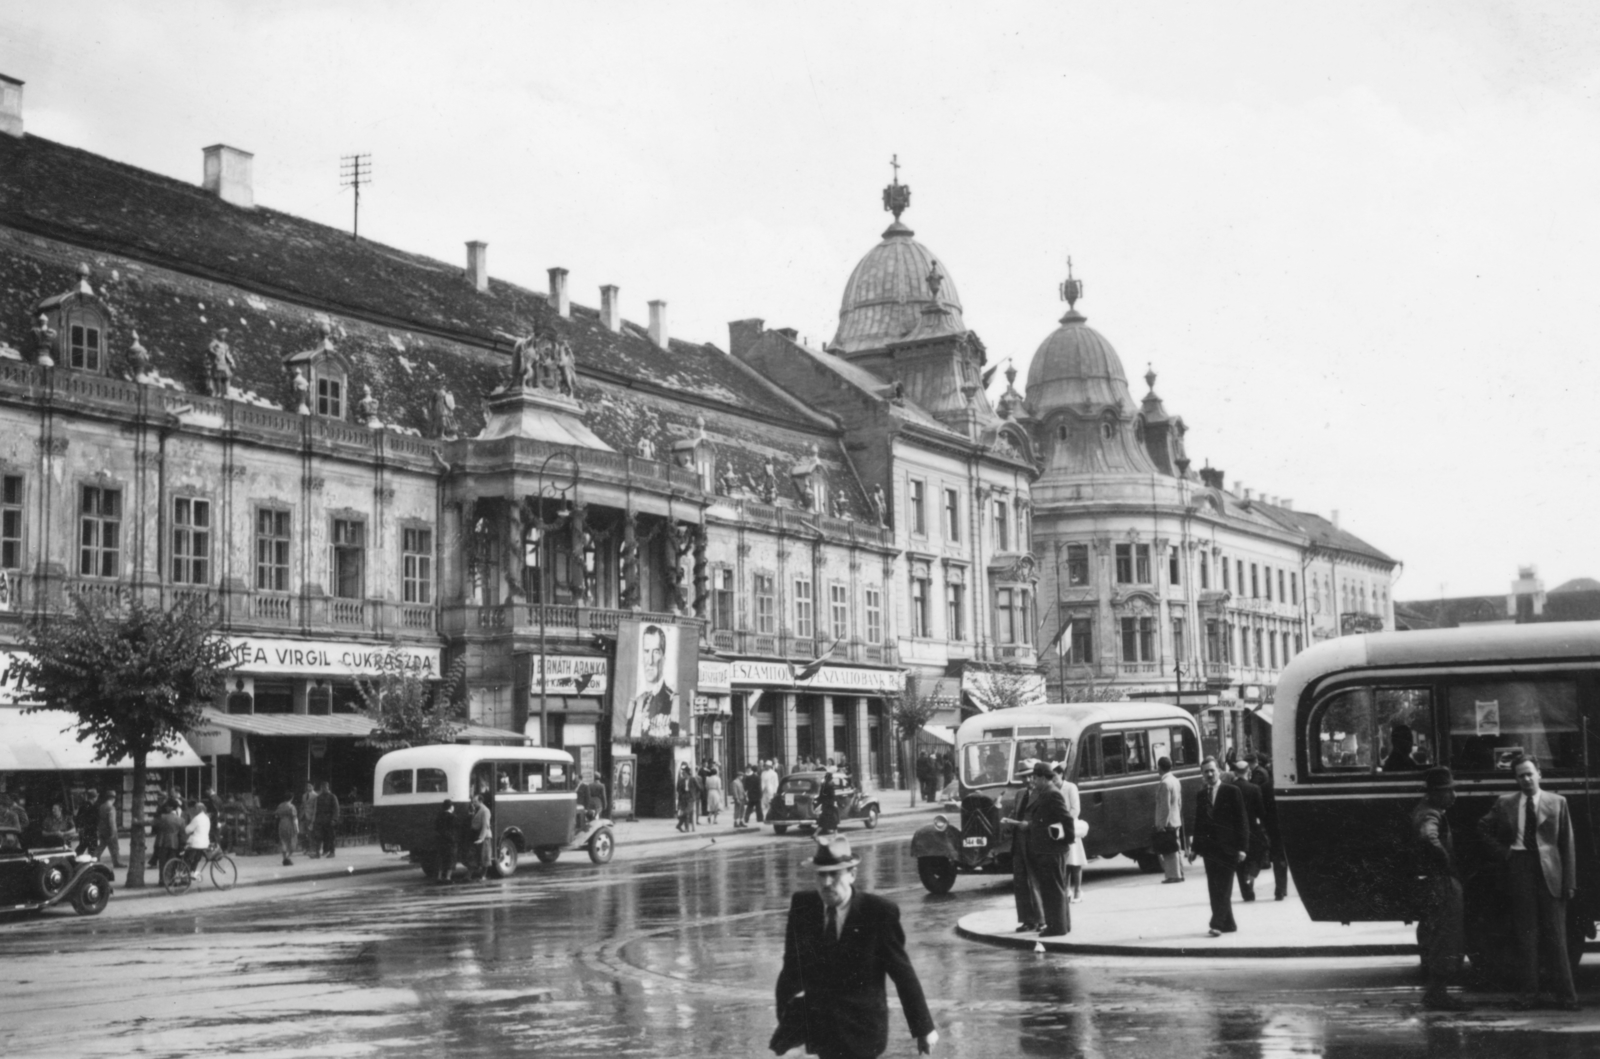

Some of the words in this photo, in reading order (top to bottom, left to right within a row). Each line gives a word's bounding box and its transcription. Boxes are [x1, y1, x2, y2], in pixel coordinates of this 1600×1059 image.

[275, 648, 331, 666] VIRGIL
[537, 656, 572, 674] BRNÁTH
[574, 660, 606, 676] ARANKA
